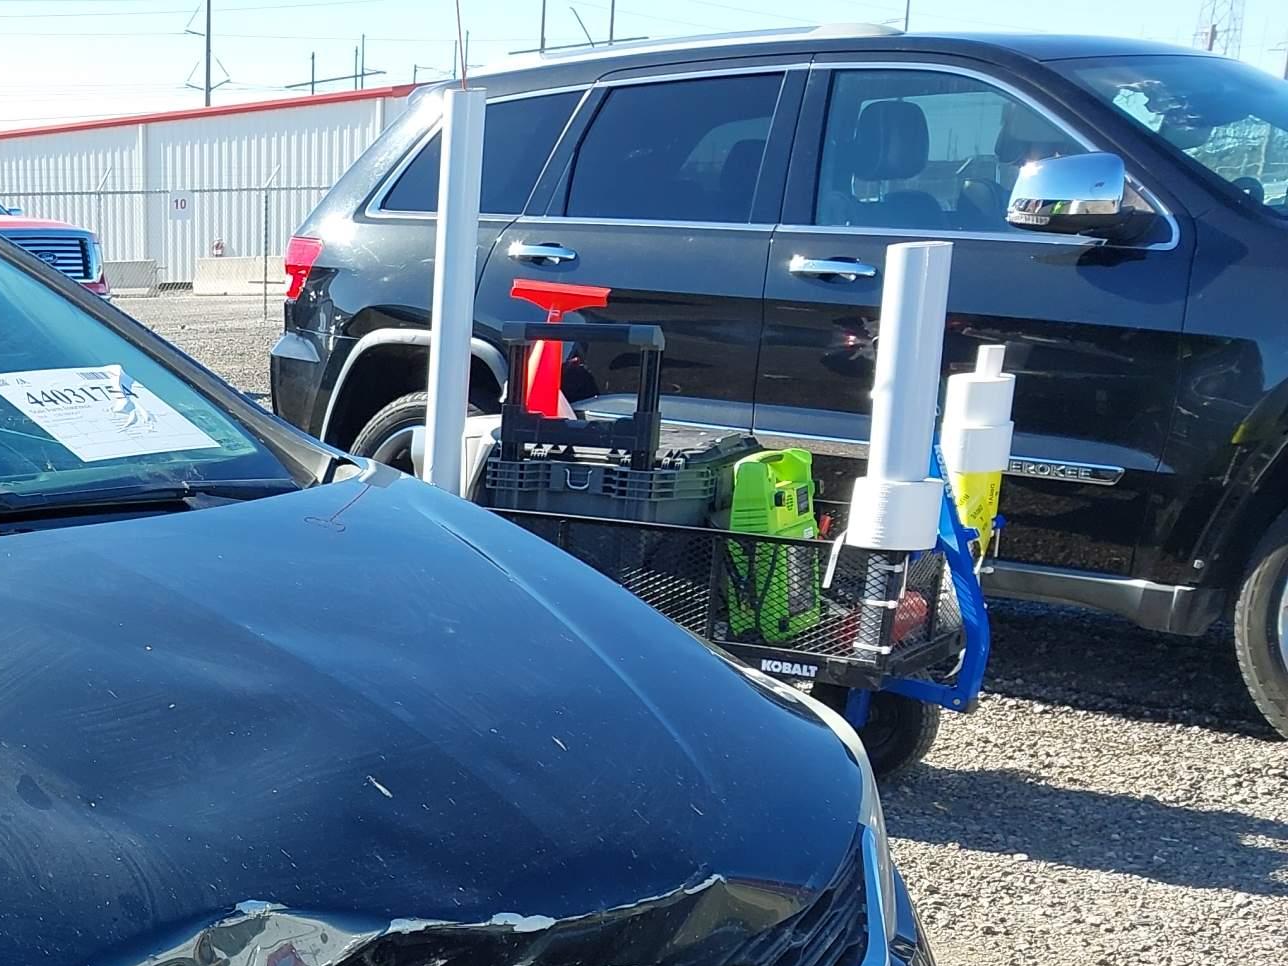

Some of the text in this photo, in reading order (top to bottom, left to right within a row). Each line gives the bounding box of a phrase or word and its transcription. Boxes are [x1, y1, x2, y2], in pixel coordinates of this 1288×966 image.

[174, 199, 187, 210] 10
[1009, 460, 1093, 479] EROKEE
[760, 659, 818, 677] KOBALT
